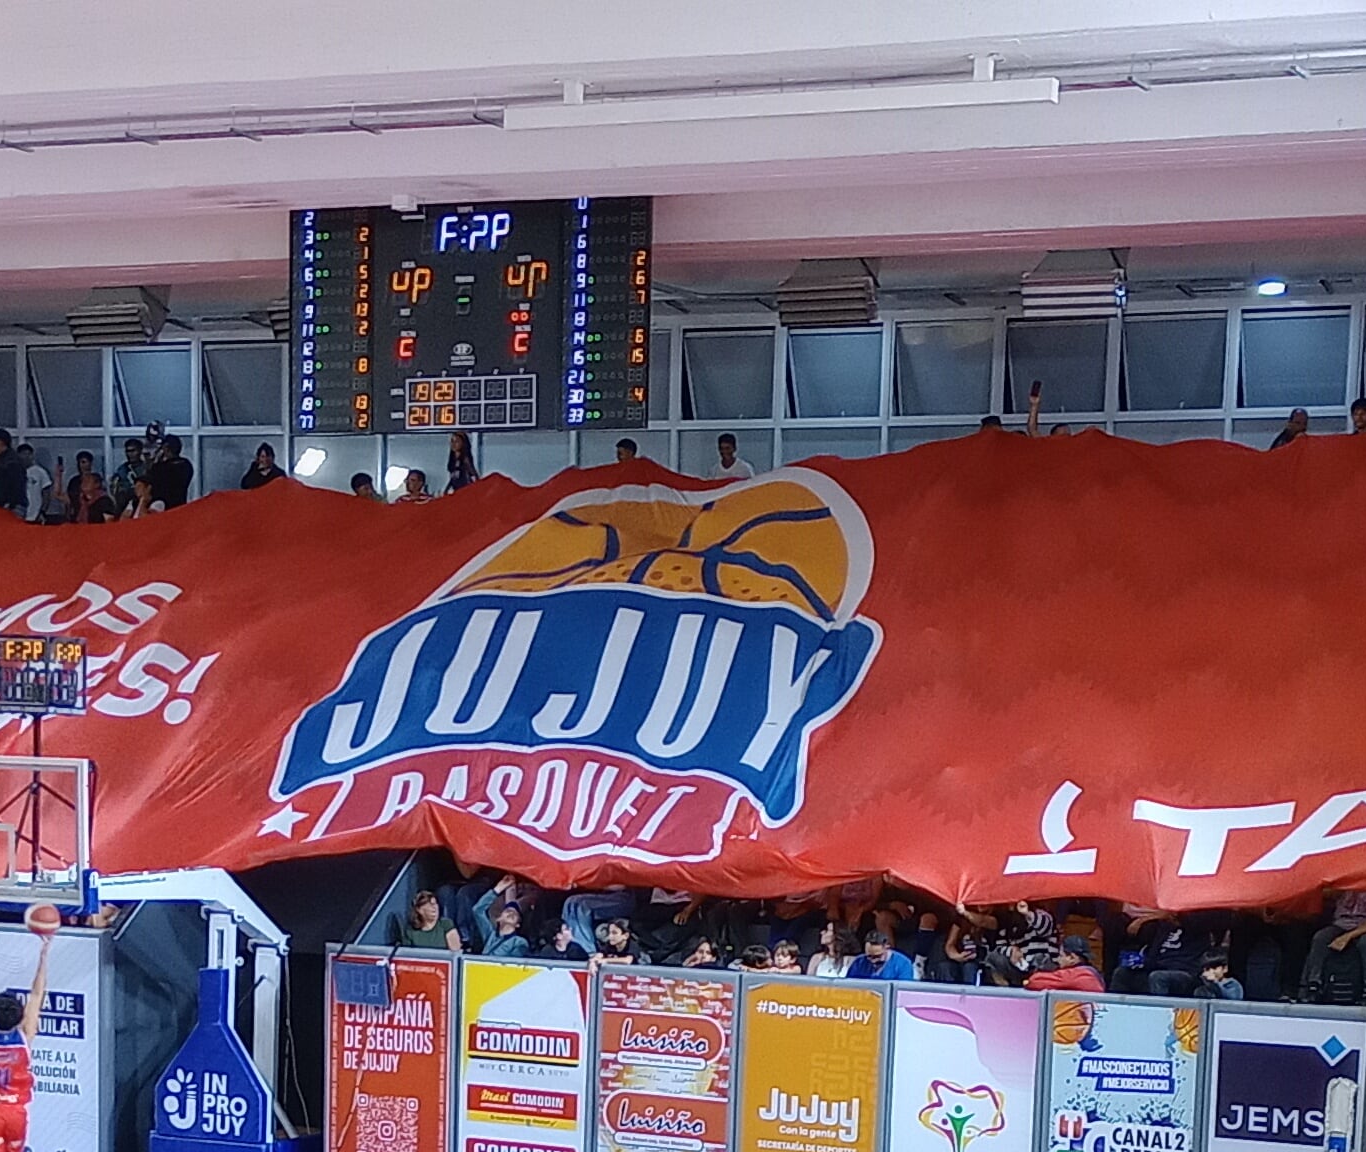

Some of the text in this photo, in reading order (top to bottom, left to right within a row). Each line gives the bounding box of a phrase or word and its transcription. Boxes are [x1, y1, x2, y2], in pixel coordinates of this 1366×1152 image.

[305, 229, 314, 245] 3
[359, 227, 370, 242] 2
[577, 235, 587, 248] 6
[304, 249, 314, 262] 4
[363, 246, 369, 261] 1
[577, 254, 586, 268] 8
[636, 251, 646, 266] 2
[304, 267, 314, 282] 6
[359, 264, 368, 280] 5
[636, 270, 645, 285] 6
[577, 274, 586, 288] 9
[359, 283, 369, 299] 2
[637, 290, 645, 304] 7
[574, 294, 585, 308] 11
[304, 305, 314, 319] 9
[355, 302, 369, 317] 13
[302, 323, 314, 338] 11
[358, 321, 368, 336] 2
[635, 329, 644, 344] 6
[631, 348, 644, 363] 15
[568, 370, 584, 384] 21
[415, 383, 429, 400] 19
[435, 383, 454, 399] 29
[634, 387, 643, 402] 4
[358, 414, 368, 429] 2
[410, 407, 429, 424] 24
[322, 607, 833, 771] JUJUY
[56, 996, 75, 1011] DE
[345, 994, 434, 1028] COMPAÑÍA
[756, 999, 872, 1025] #DeportesJujuy
[344, 1024, 434, 1054] DE SEGUROS
[621, 1018, 709, 1053] Luisiño
[476, 1031, 571, 1057] COMODIN
[55, 1051, 63, 1062] A
[64, 1052, 76, 1064] LA
[343, 1050, 400, 1073] DE JUJUY
[498, 1063, 545, 1076] CERCA
[1083, 1059, 1170, 1076] #MASCONECTADOS
[203, 1072, 228, 1095] IN
[202, 1094, 248, 1117] PRO
[512, 1092, 564, 1109] COMODIN
[618, 1098, 705, 1134] Luisiño
[1221, 1104, 1325, 1138] JEMS
[202, 1113, 246, 1136] JUY
[779, 1125, 836, 1140] Con la gente
[806, 1143, 815, 1152] DE
